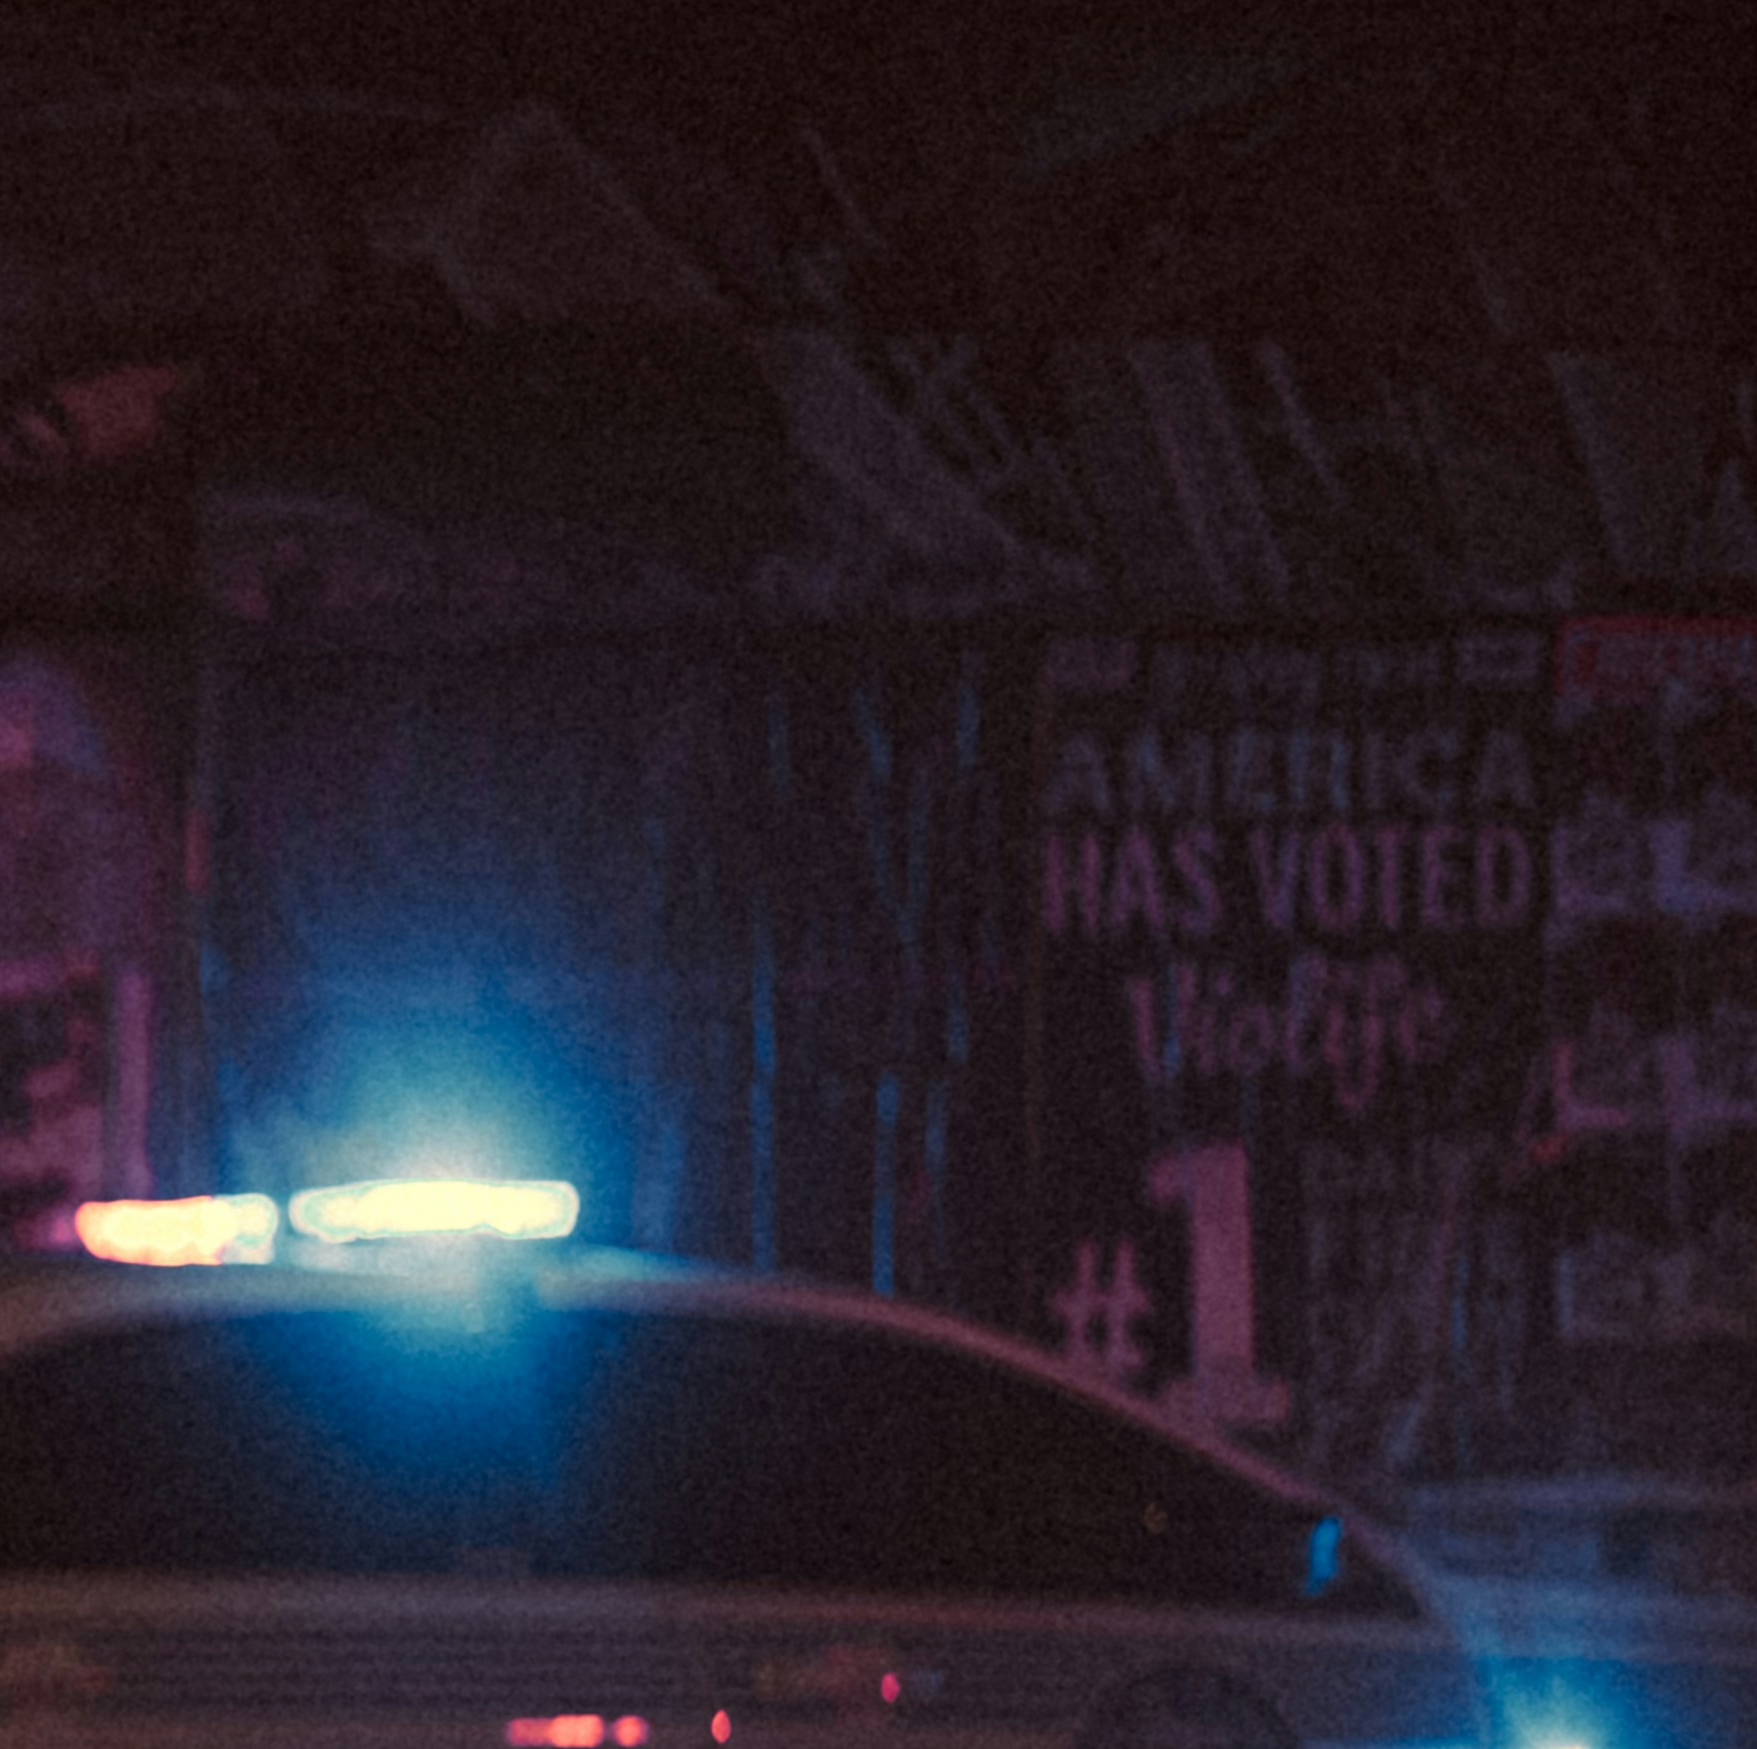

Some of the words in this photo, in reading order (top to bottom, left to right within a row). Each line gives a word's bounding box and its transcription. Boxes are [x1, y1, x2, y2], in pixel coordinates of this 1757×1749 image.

[1041, 726, 1535, 814] AMERICA
[1040, 824, 1225, 937] HAS
[1247, 822, 1535, 934] VOTED
[1047, 1140, 1295, 1428] #1
